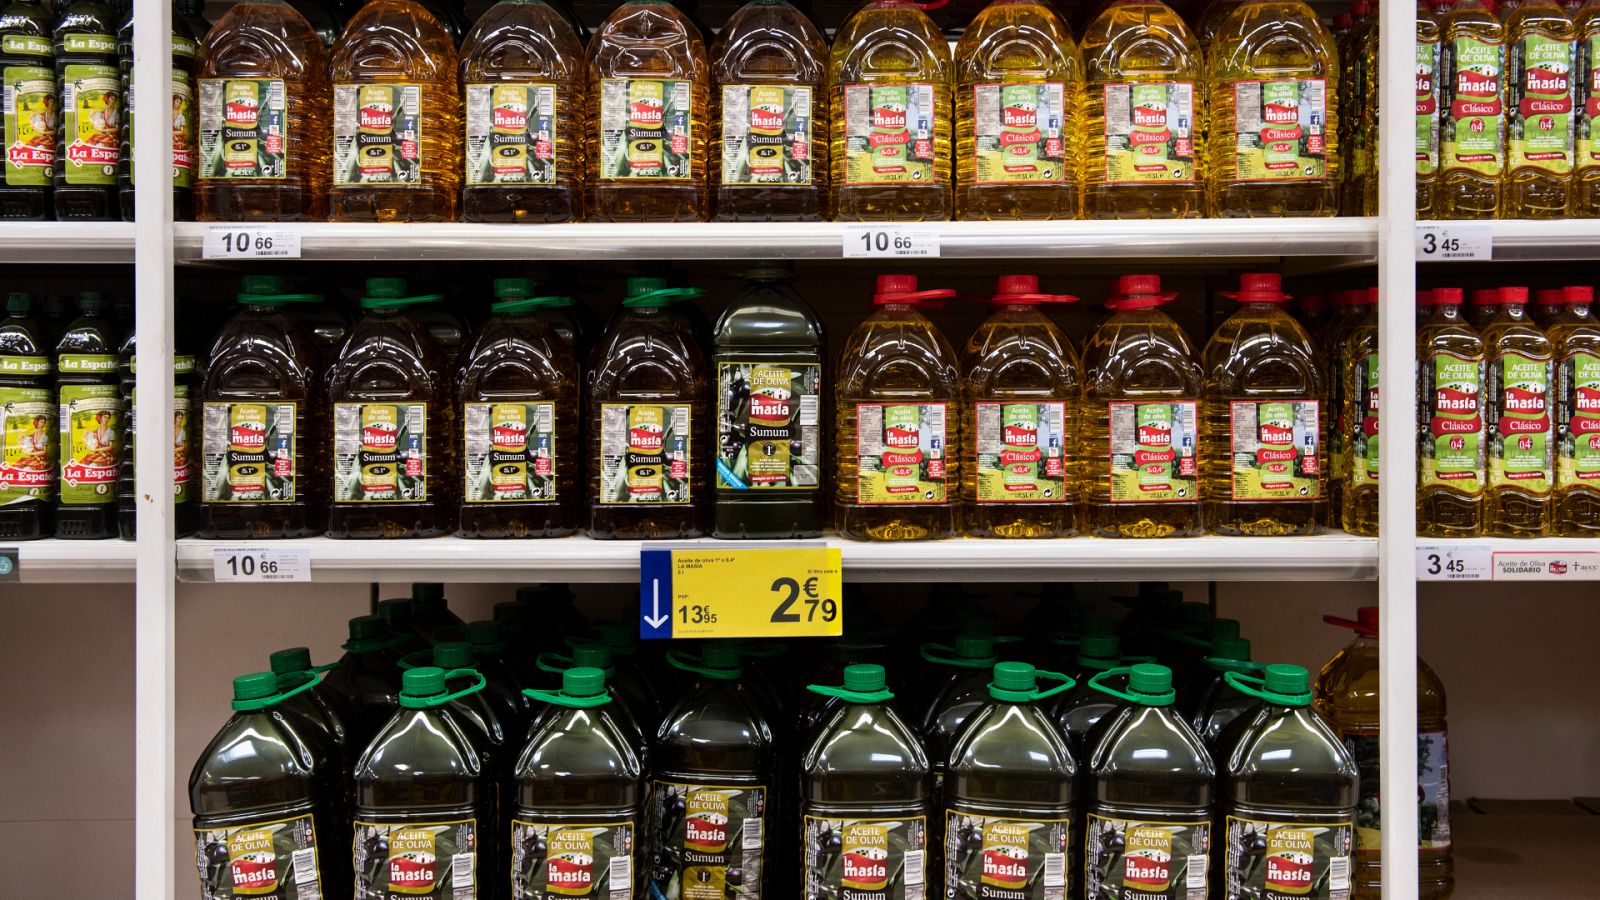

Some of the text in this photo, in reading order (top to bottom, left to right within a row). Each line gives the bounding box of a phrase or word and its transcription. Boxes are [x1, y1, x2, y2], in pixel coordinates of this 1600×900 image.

[71, 39, 84, 48] La
[1462, 104, 1493, 112] Clásico
[1531, 101, 1563, 110] Clásico
[13, 151, 27, 160] La
[72, 149, 86, 158] La
[222, 232, 272, 252] 10 66
[861, 232, 911, 251] 10 66
[1423, 233, 1437, 254] 3
[1442, 239, 1459, 251] 45
[4, 361, 16, 369] La
[64, 360, 78, 369] La
[1442, 421, 1473, 430] Clásico
[1510, 421, 1541, 430] Clásico
[750, 427, 788, 437] Sumum
[67, 469, 81, 477] La
[227, 556, 278, 575] 10 66
[1427, 554, 1442, 574] 3
[1446, 560, 1464, 572] 45
[770, 577, 837, 622] 2 € 79
[679, 605, 717, 624] 13 € 95
[236, 833, 264, 842] ACEITE
[1134, 830, 1164, 838] ACEITE
[1276, 832, 1306, 840] ACEITE
[1001, 835, 1025, 844] OLIVA
[1144, 839, 1168, 847] OLIVA
[245, 840, 270, 849] OLIVA
[1285, 841, 1311, 849] OLIVA
[685, 852, 724, 863] Sumum
[844, 857, 852, 866] la
[984, 855, 992, 864] la
[1126, 858, 1135, 867] la
[1268, 861, 1277, 869] la
[232, 865, 240, 874] la
[549, 863, 557, 872] la
[843, 891, 885, 900] Sumum
[982, 888, 1025, 900] Sumum
[1125, 891, 1167, 900] Sumum
